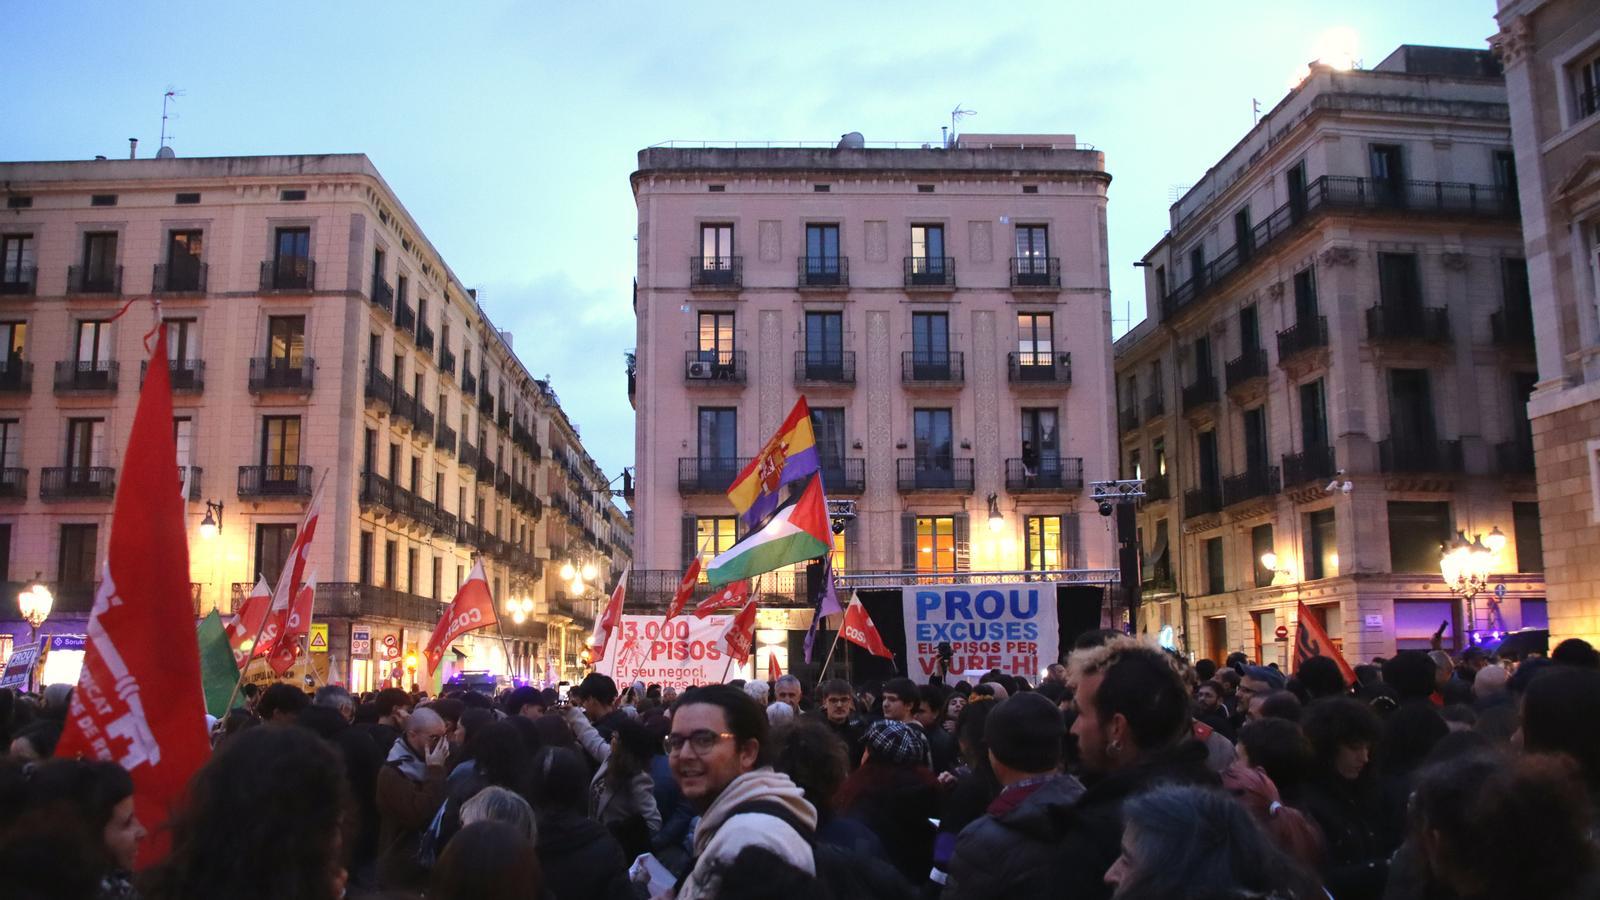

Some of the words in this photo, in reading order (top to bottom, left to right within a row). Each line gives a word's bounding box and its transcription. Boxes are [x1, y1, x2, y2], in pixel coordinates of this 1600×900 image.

[916, 590, 1039, 620] PROU
[618, 621, 690, 640] 13.000
[916, 622, 1039, 641] EXCUSES
[651, 640, 721, 660] PISOS
[953, 642, 1001, 654] PISOS
[1007, 641, 1038, 654] PER
[632, 668, 655, 677] seu
[918, 655, 1038, 676] VURE-HI
